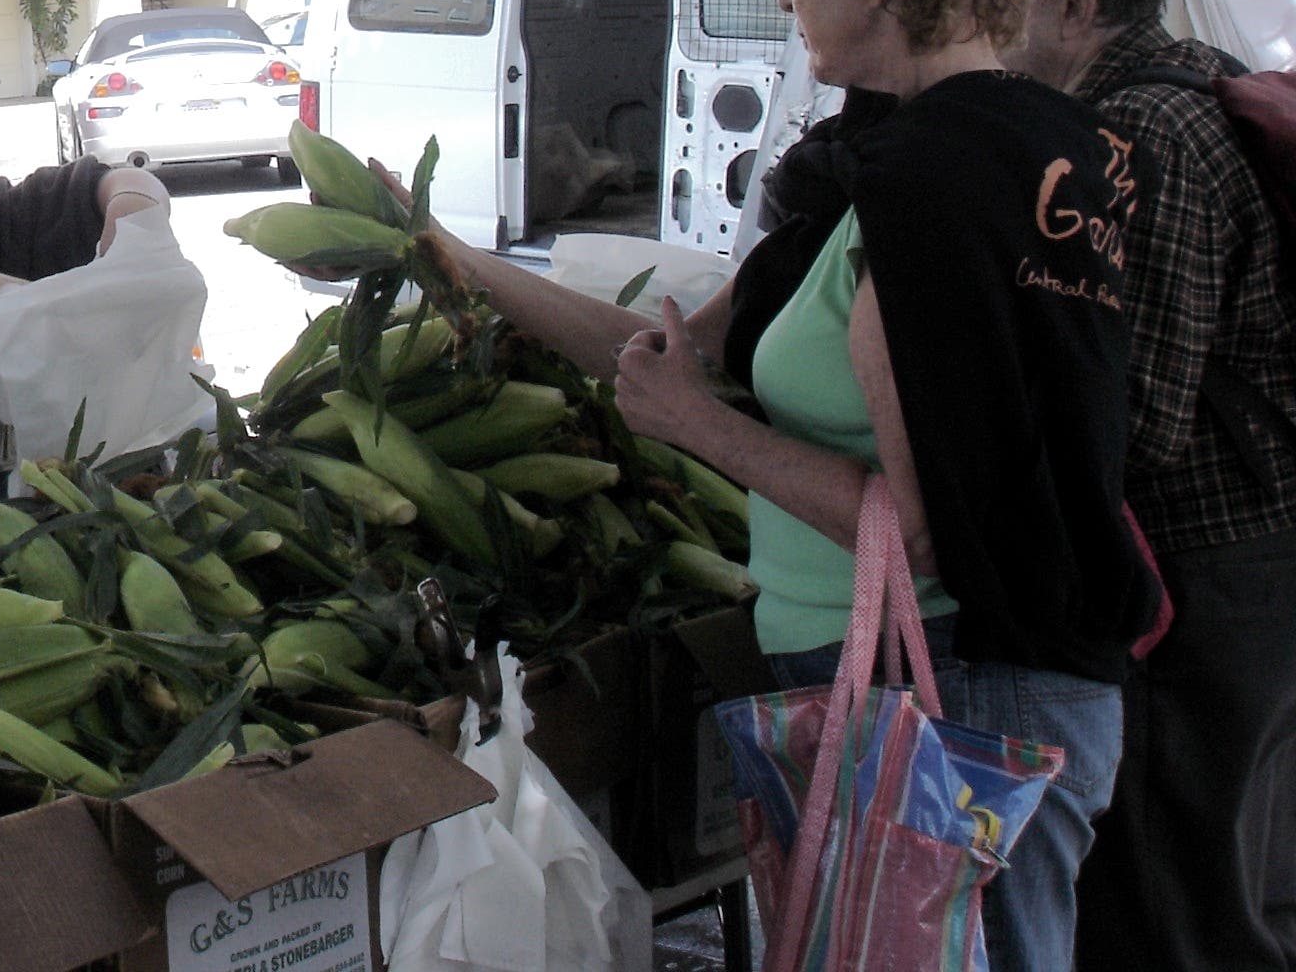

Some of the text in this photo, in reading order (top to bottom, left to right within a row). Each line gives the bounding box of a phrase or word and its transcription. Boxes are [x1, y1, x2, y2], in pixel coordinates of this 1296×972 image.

[190, 870, 350, 954] G&S FARMS
[264, 938, 279, 951] AND
[312, 922, 322, 933] BY
[271, 923, 354, 971] STONEBARGER
